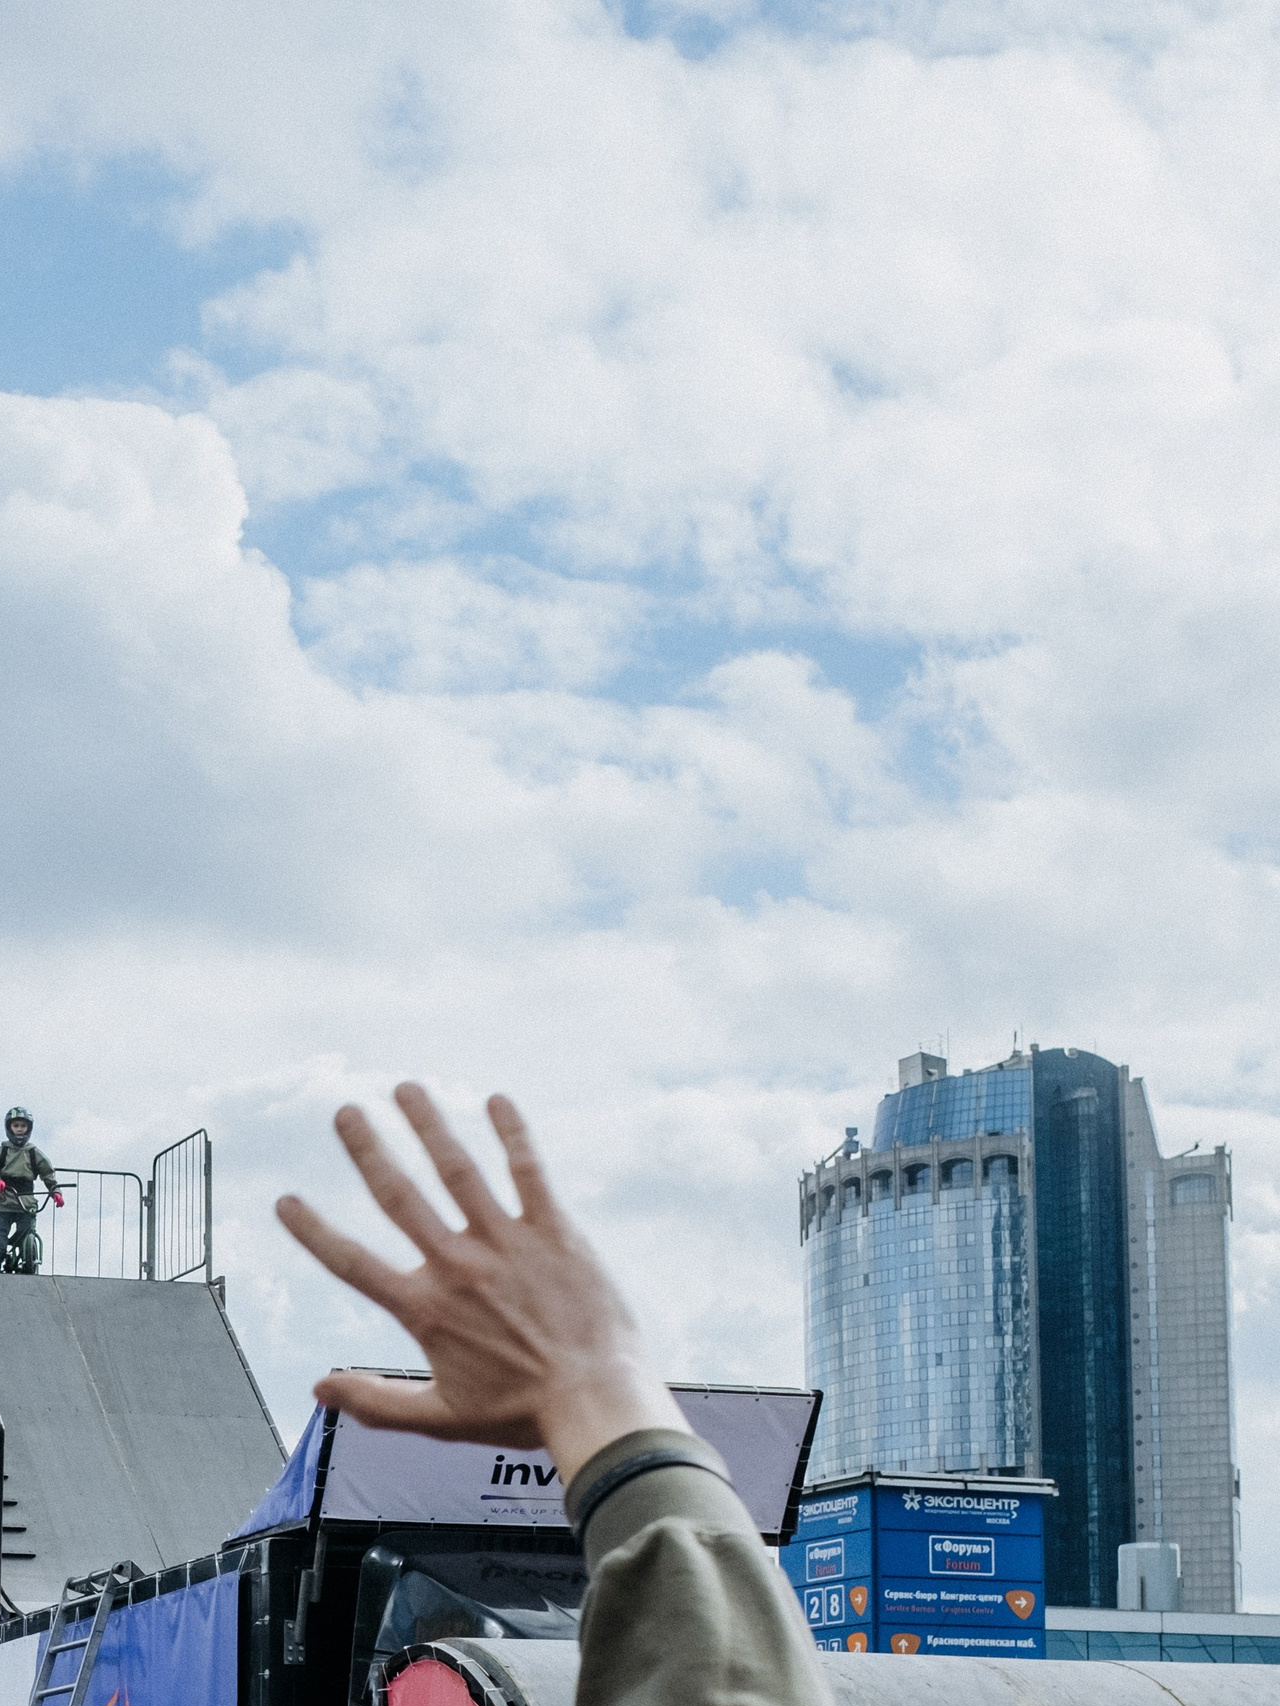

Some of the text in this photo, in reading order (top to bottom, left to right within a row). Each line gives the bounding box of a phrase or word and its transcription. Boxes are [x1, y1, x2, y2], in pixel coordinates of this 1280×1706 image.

[491, 1455, 564, 1487] inv
[803, 1496, 858, 1516] ЭКСПОЦЕНТР
[924, 1496, 1020, 1510] ЭКСПОЦЕНТР
[490, 1507, 527, 1515] WAKE
[986, 1517, 1011, 1525] МОСКВА
[934, 1540, 991, 1557] «Форум»
[945, 1557, 981, 1571] Forum
[884, 1589, 1004, 1604] Сервис-бюро Конгресс-центр
[809, 1593, 840, 1619] 2 8
[927, 1635, 1037, 1648] Краснопресненская наб.
